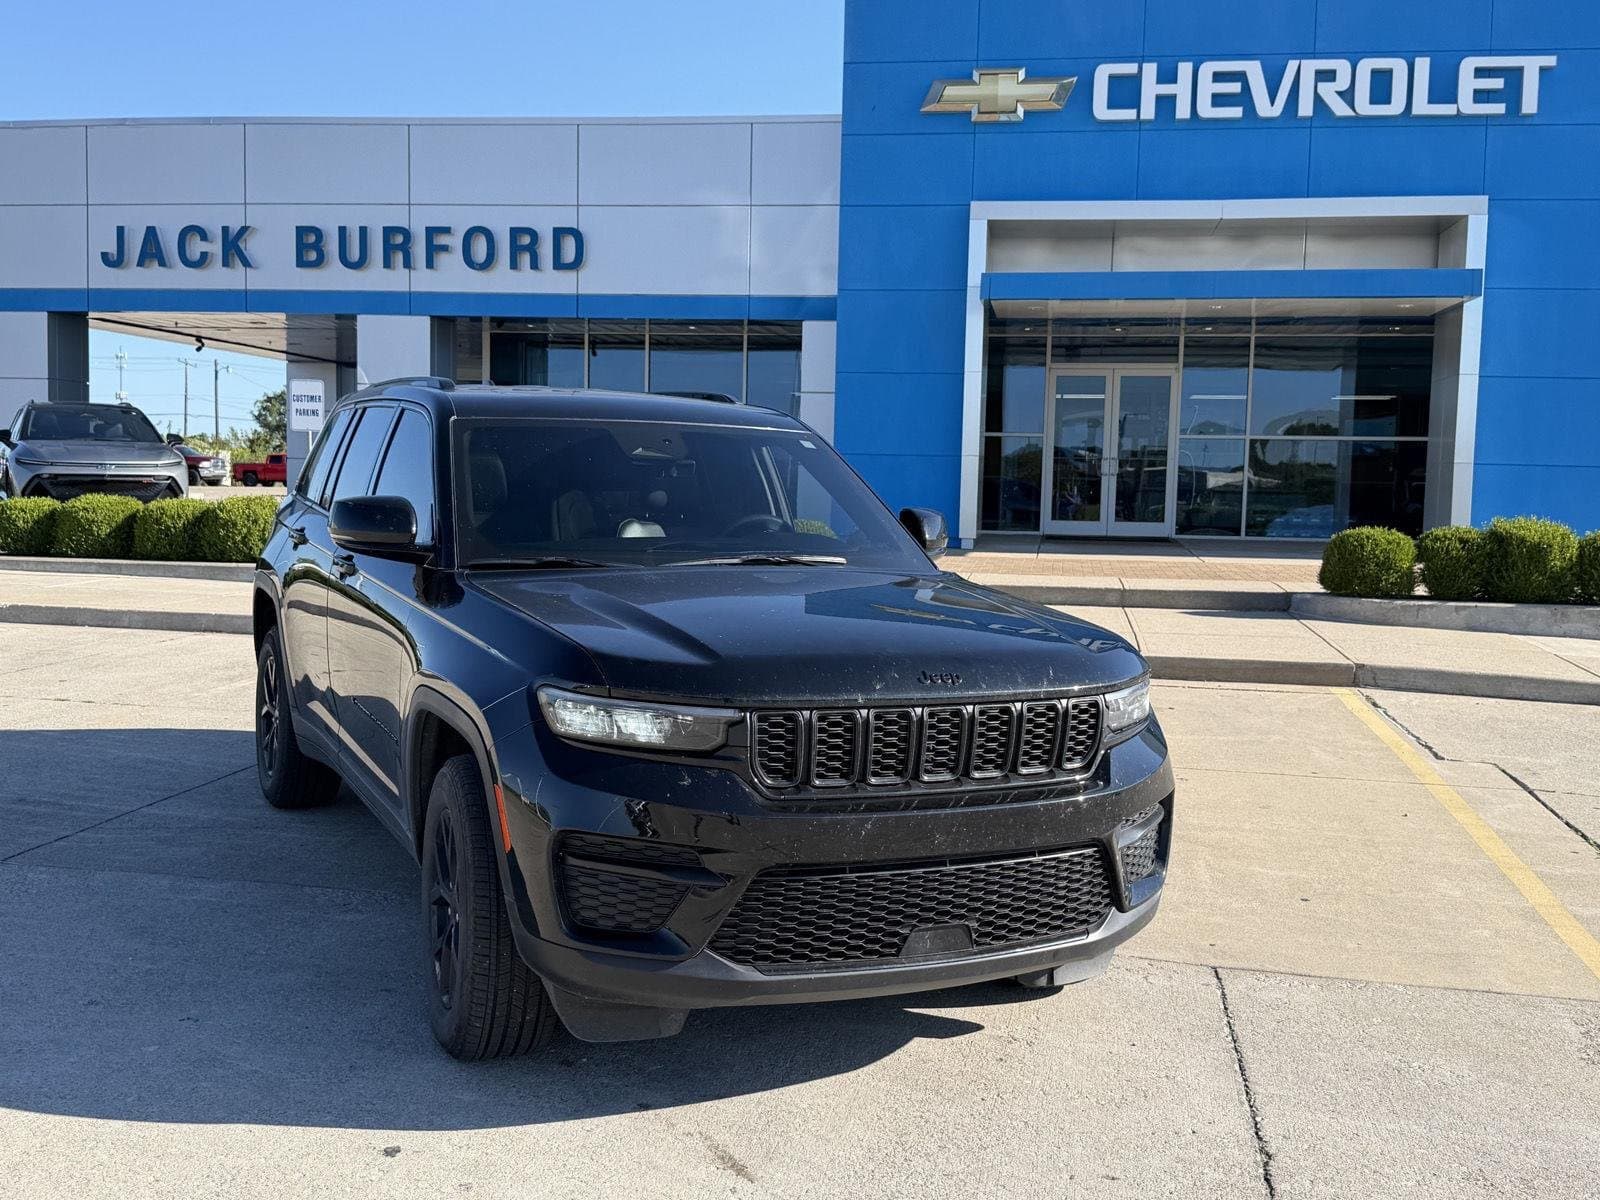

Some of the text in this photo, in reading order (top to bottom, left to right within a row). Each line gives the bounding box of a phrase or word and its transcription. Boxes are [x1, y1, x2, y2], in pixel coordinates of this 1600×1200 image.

[1093, 55, 1557, 121] CHEVROLET
[101, 225, 584, 270] JACK BURFORD
[292, 394, 321, 403] CUSTOMER
[295, 408, 319, 417] PARKING
[917, 670, 962, 686] Jeep
